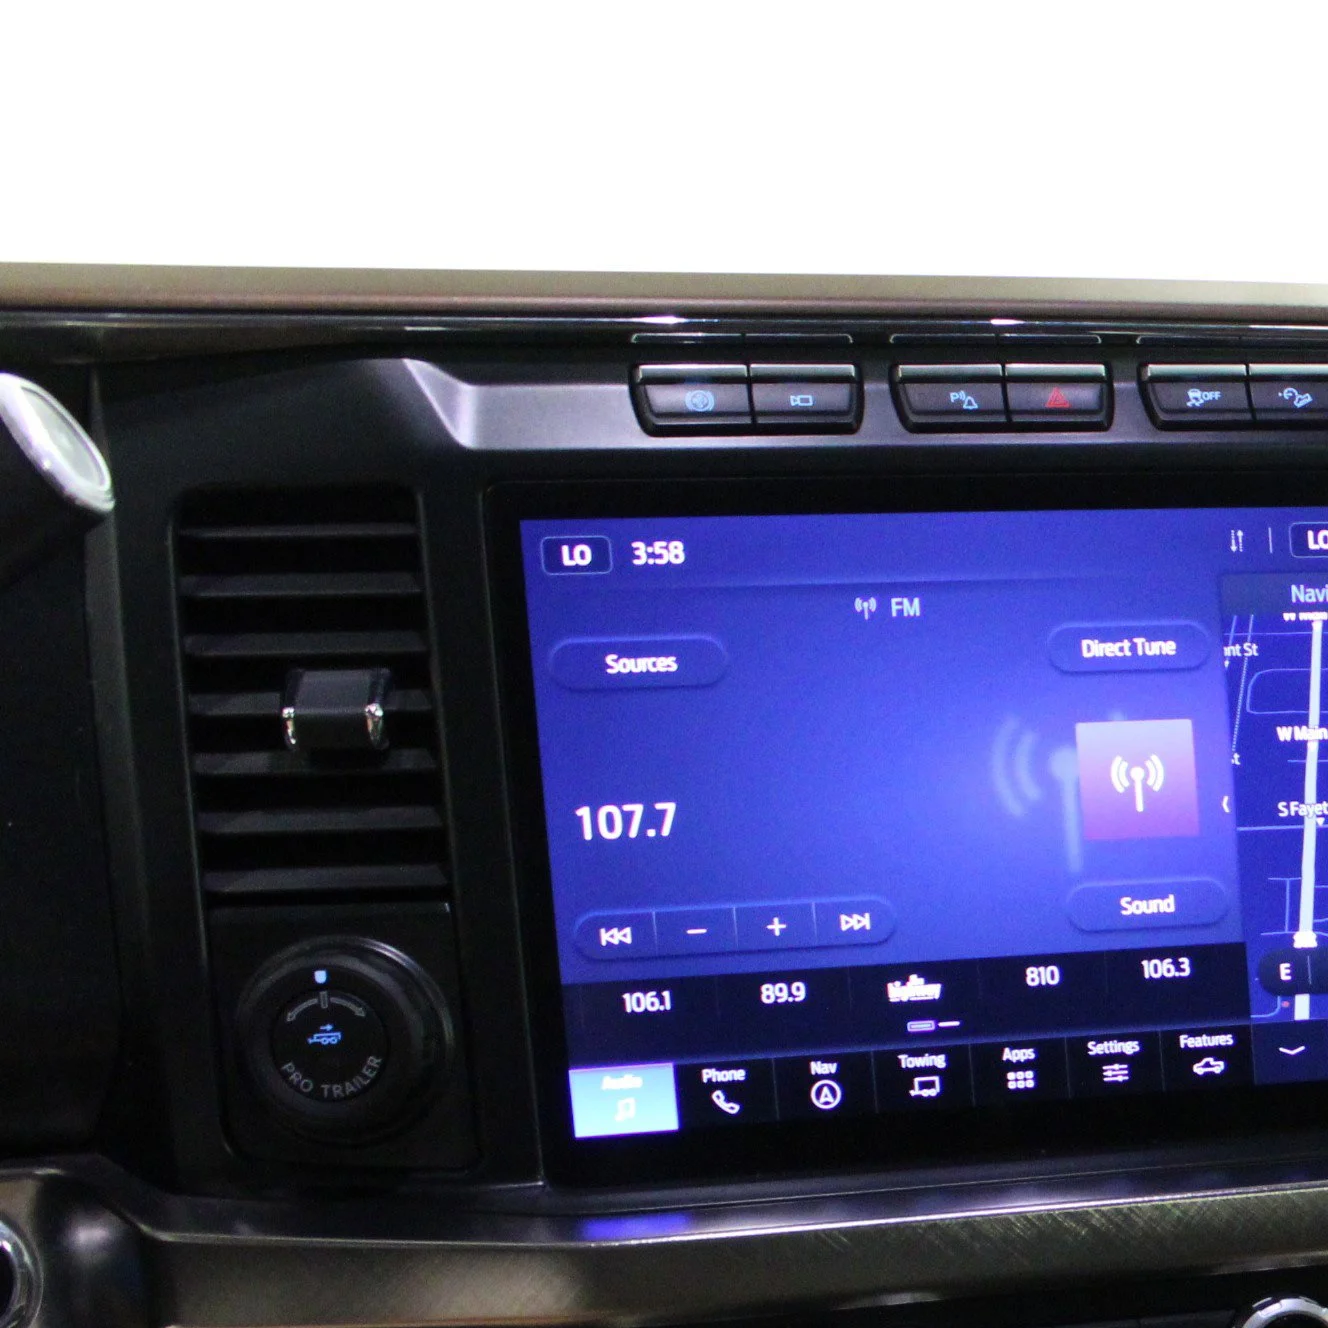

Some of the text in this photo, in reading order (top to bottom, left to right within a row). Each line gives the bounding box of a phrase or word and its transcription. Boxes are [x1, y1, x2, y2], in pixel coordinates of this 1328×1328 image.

[1203, 390, 1221, 401] OFF
[561, 543, 593, 567] LO
[631, 540, 686, 566] 3:58
[890, 597, 921, 618] FM
[1081, 636, 1177, 659] Direct Tune
[1243, 642, 1259, 657] St
[604, 653, 678, 675] Sources
[1276, 725, 1292, 742] W
[1293, 725, 1328, 741] Main
[1277, 801, 1288, 818] S
[575, 801, 677, 841] 107.7
[1120, 893, 1176, 916] Sound
[1025, 965, 1060, 987] 810
[1141, 957, 1191, 979] 106.3
[1279, 962, 1291, 981] E
[622, 990, 672, 1014] 106.1
[760, 981, 806, 1005] 89.9
[1087, 1039, 1140, 1056] Settings
[1179, 1032, 1234, 1050] Features
[898, 1053, 947, 1070] Towing
[1002, 1047, 1036, 1064] Apps
[281, 1055, 382, 1099] PRO TRAILER
[701, 1067, 746, 1084] Phone
[810, 1060, 838, 1076] Nav
